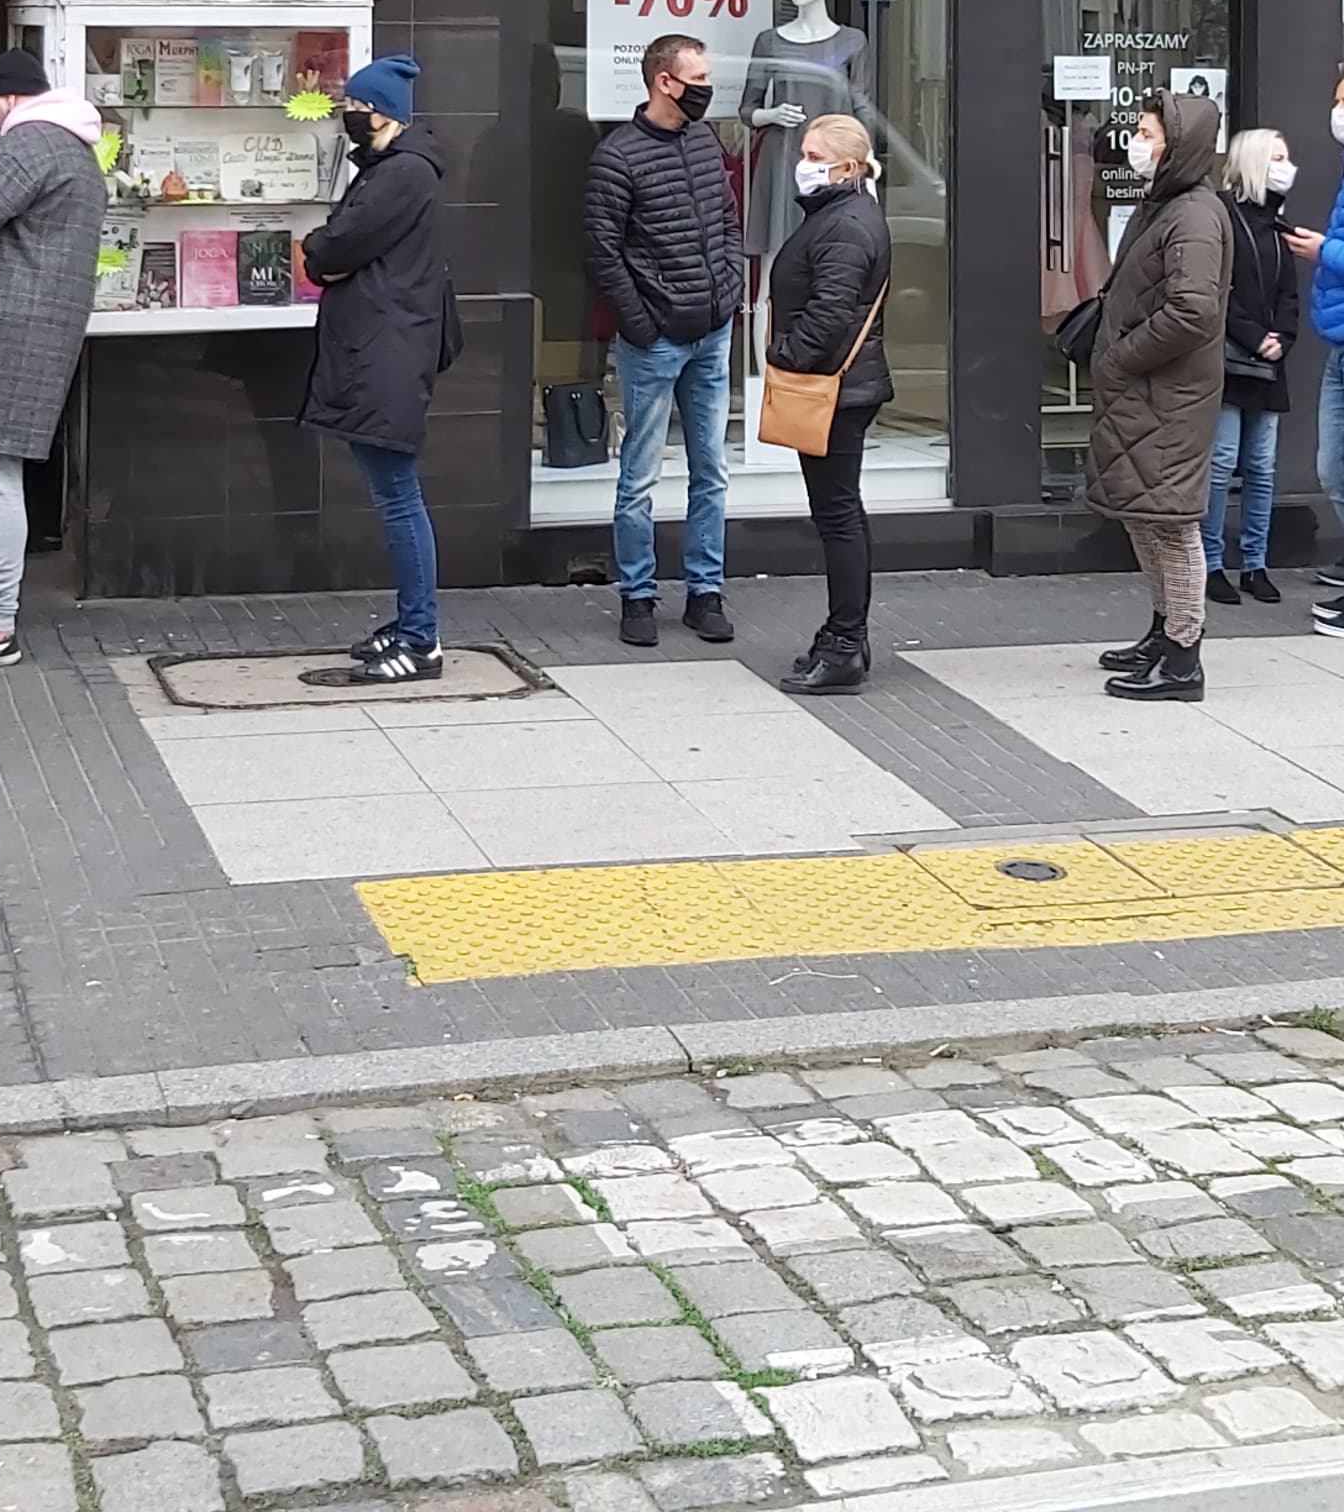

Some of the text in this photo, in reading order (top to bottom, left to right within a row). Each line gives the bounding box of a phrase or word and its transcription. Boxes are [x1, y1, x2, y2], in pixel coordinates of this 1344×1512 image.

[1083, 33, 1189, 49] ZAPRASZAMY
[1117, 61, 1155, 74] PN-PT
[1110, 86, 1166, 107] 10-1
[1101, 168, 1141, 180] online
